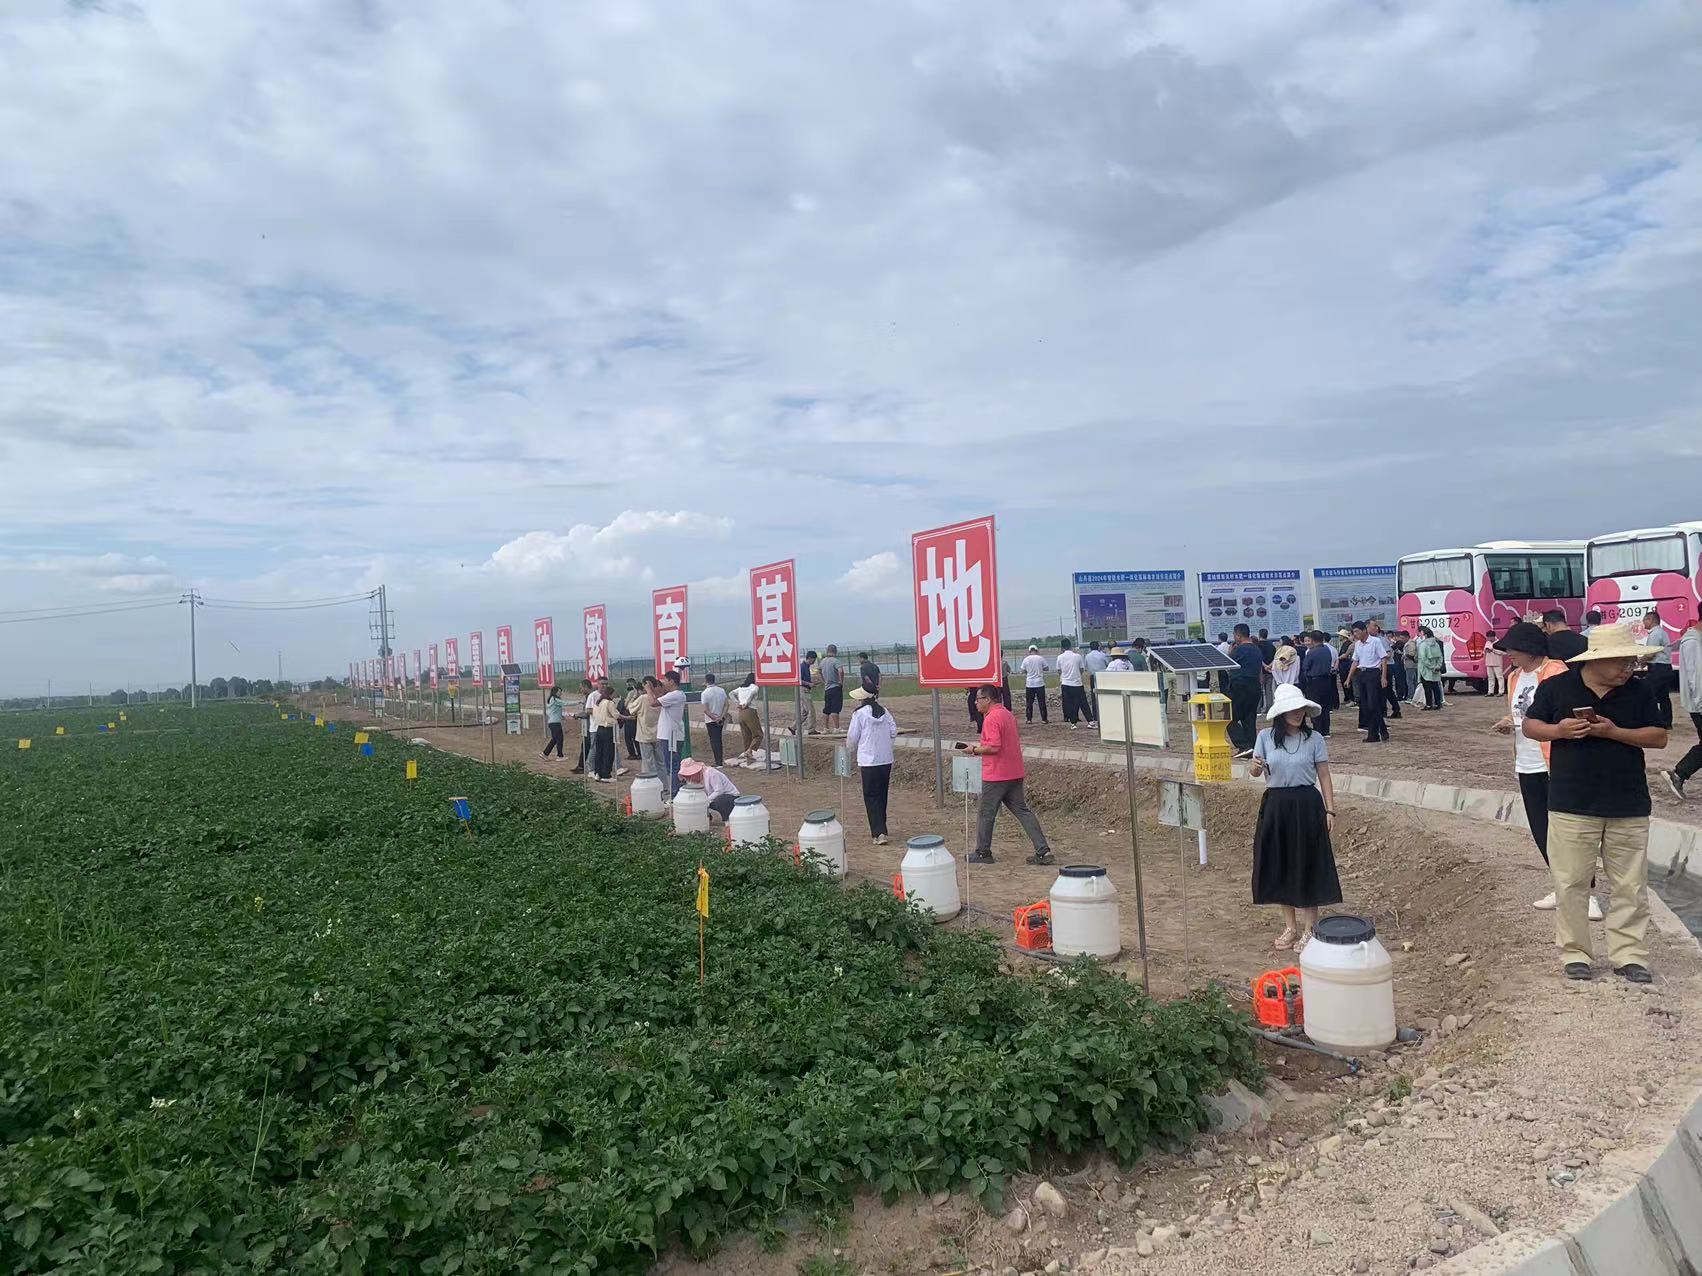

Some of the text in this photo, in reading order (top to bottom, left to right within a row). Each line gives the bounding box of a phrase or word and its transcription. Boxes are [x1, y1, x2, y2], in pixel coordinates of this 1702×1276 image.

[656, 597, 682, 676] 育
[757, 574, 793, 674] 基
[920, 539, 991, 671] 地
[537, 623, 551, 682] 种
[586, 613, 604, 679] 繁
